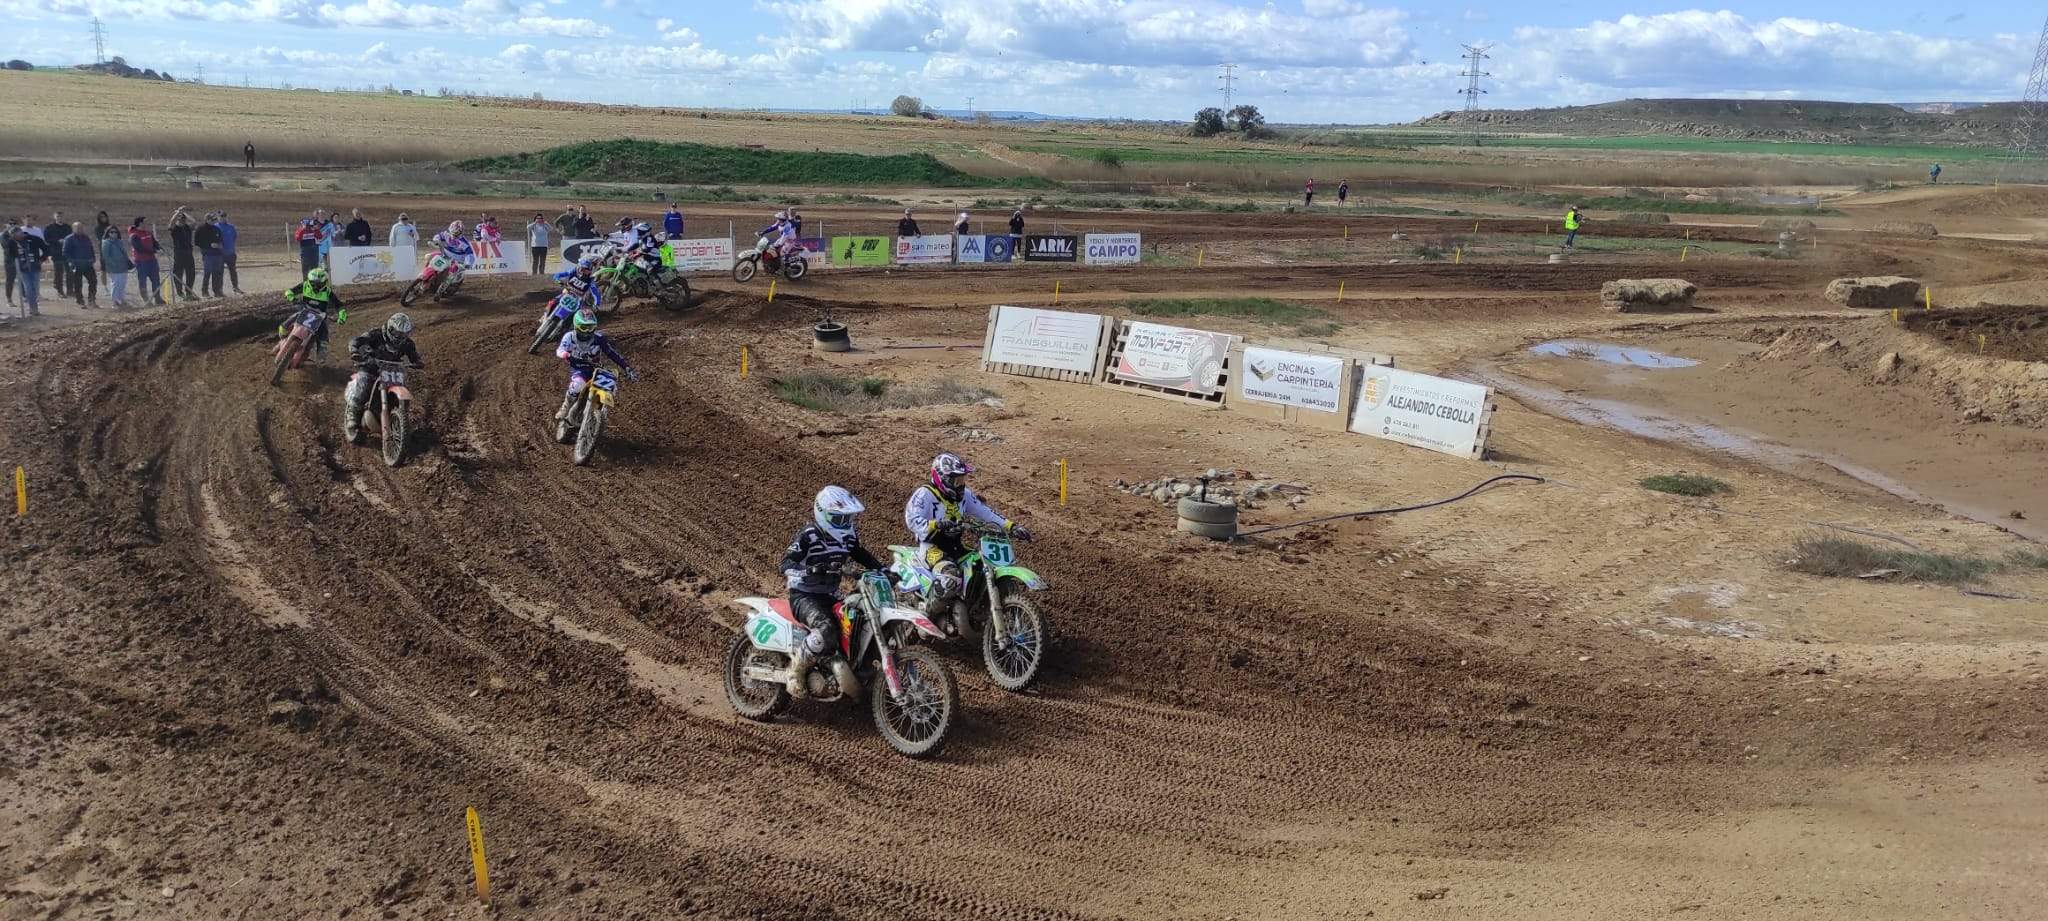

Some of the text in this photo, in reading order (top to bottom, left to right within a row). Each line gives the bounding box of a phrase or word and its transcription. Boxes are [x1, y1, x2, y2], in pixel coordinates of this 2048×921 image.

[1088, 244, 1137, 258] CAMPO
[302, 311, 316, 328] 2
[1277, 362, 1317, 376] ENCINAS
[1386, 395, 1475, 425] ALEJANDRO CEBOLLA
[988, 543, 1010, 562] 31
[753, 619, 777, 644] 18
